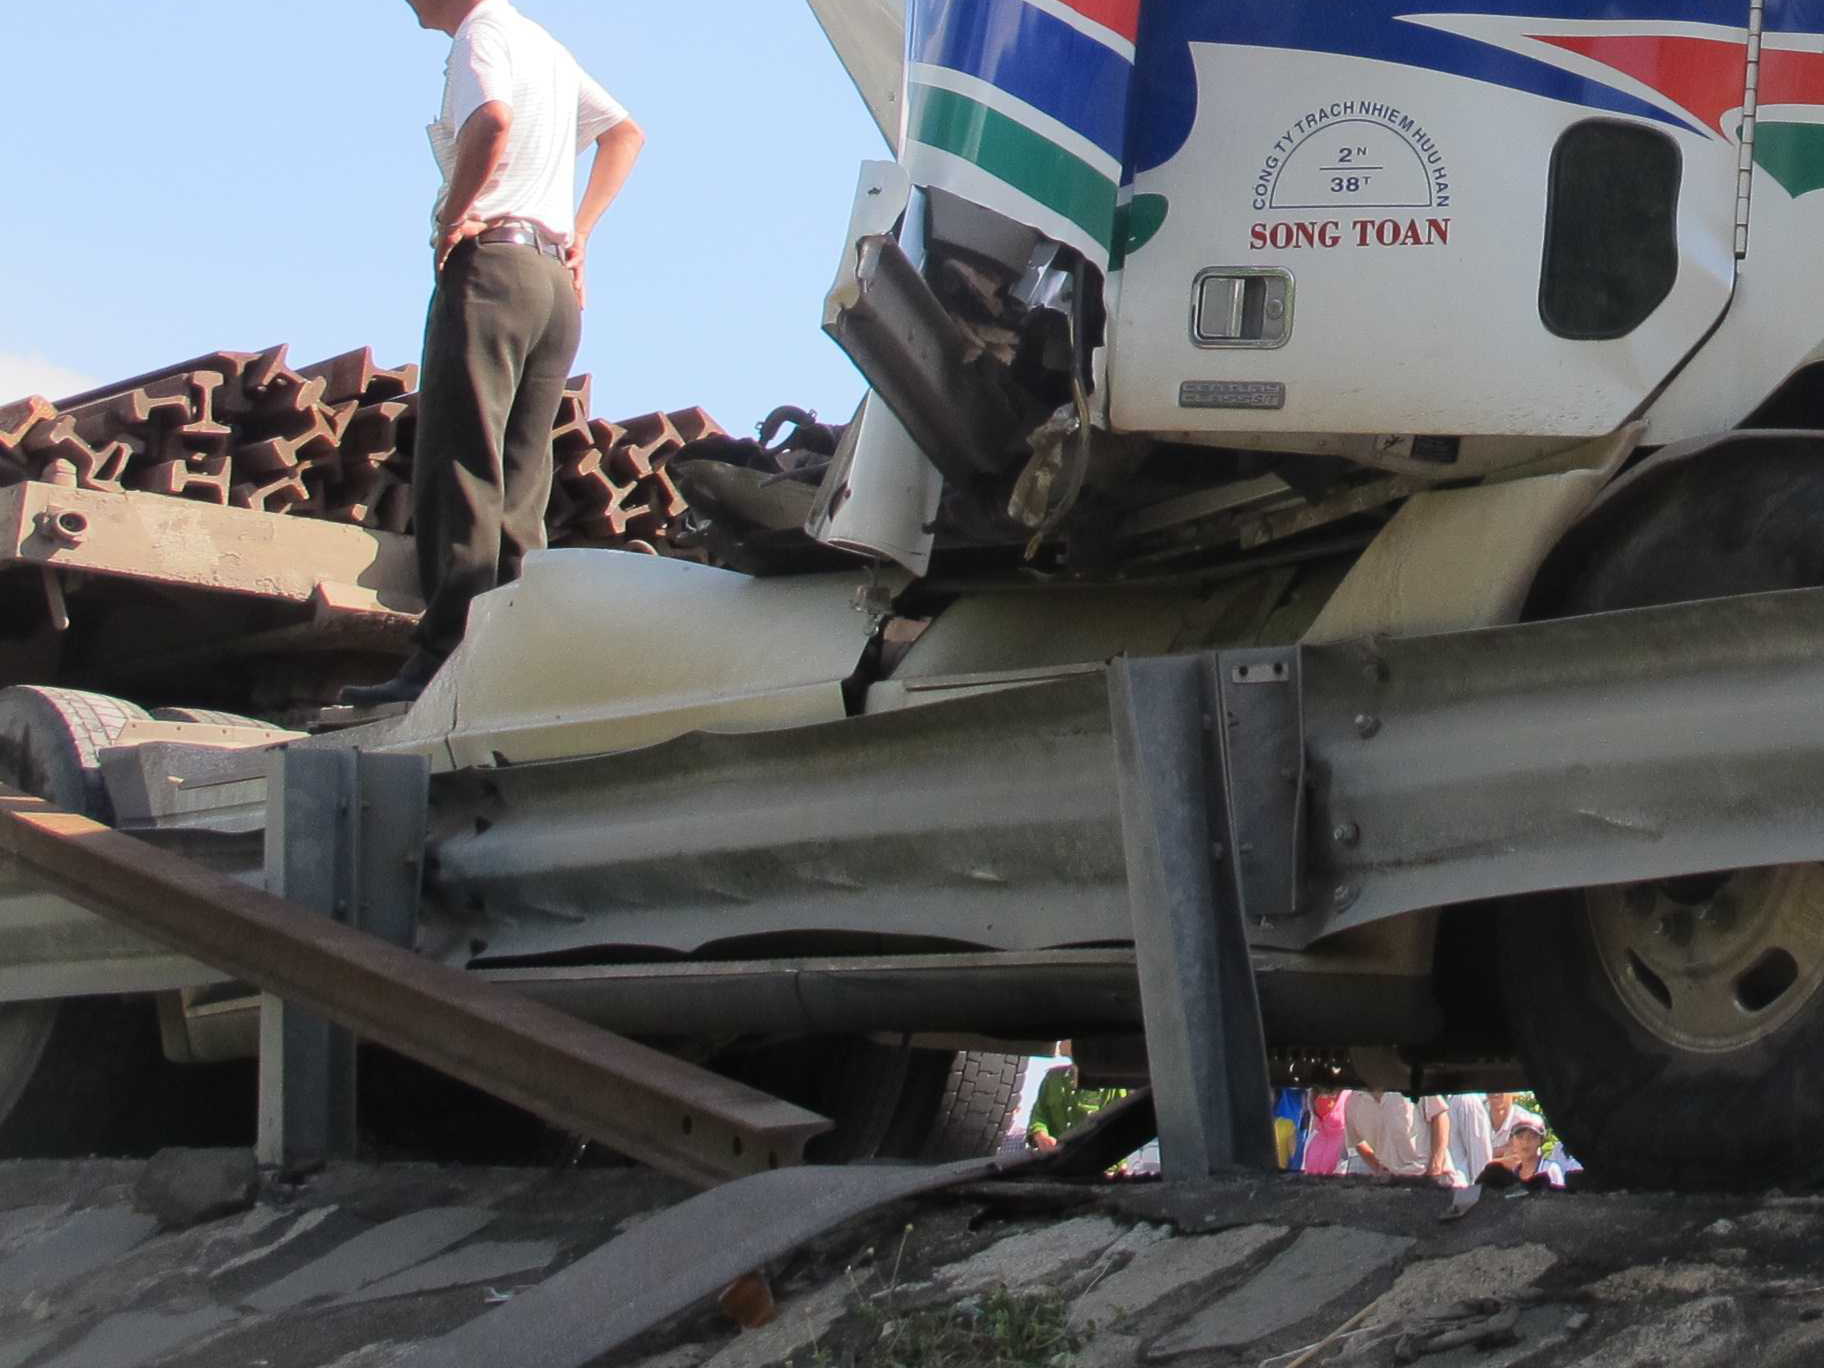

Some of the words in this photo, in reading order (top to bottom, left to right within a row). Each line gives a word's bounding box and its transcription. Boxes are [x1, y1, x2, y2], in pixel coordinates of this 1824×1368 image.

[1252, 155, 1280, 210] CONG
[1274, 130, 1294, 153] TY
[1294, 101, 1355, 134] TRACH
[1359, 100, 1416, 133] NHIEM
[1412, 127, 1443, 165] HUU
[1433, 166, 1451, 208] HAN
[1250, 220, 1342, 250] SONG
[1352, 218, 1451, 247] TOAN
